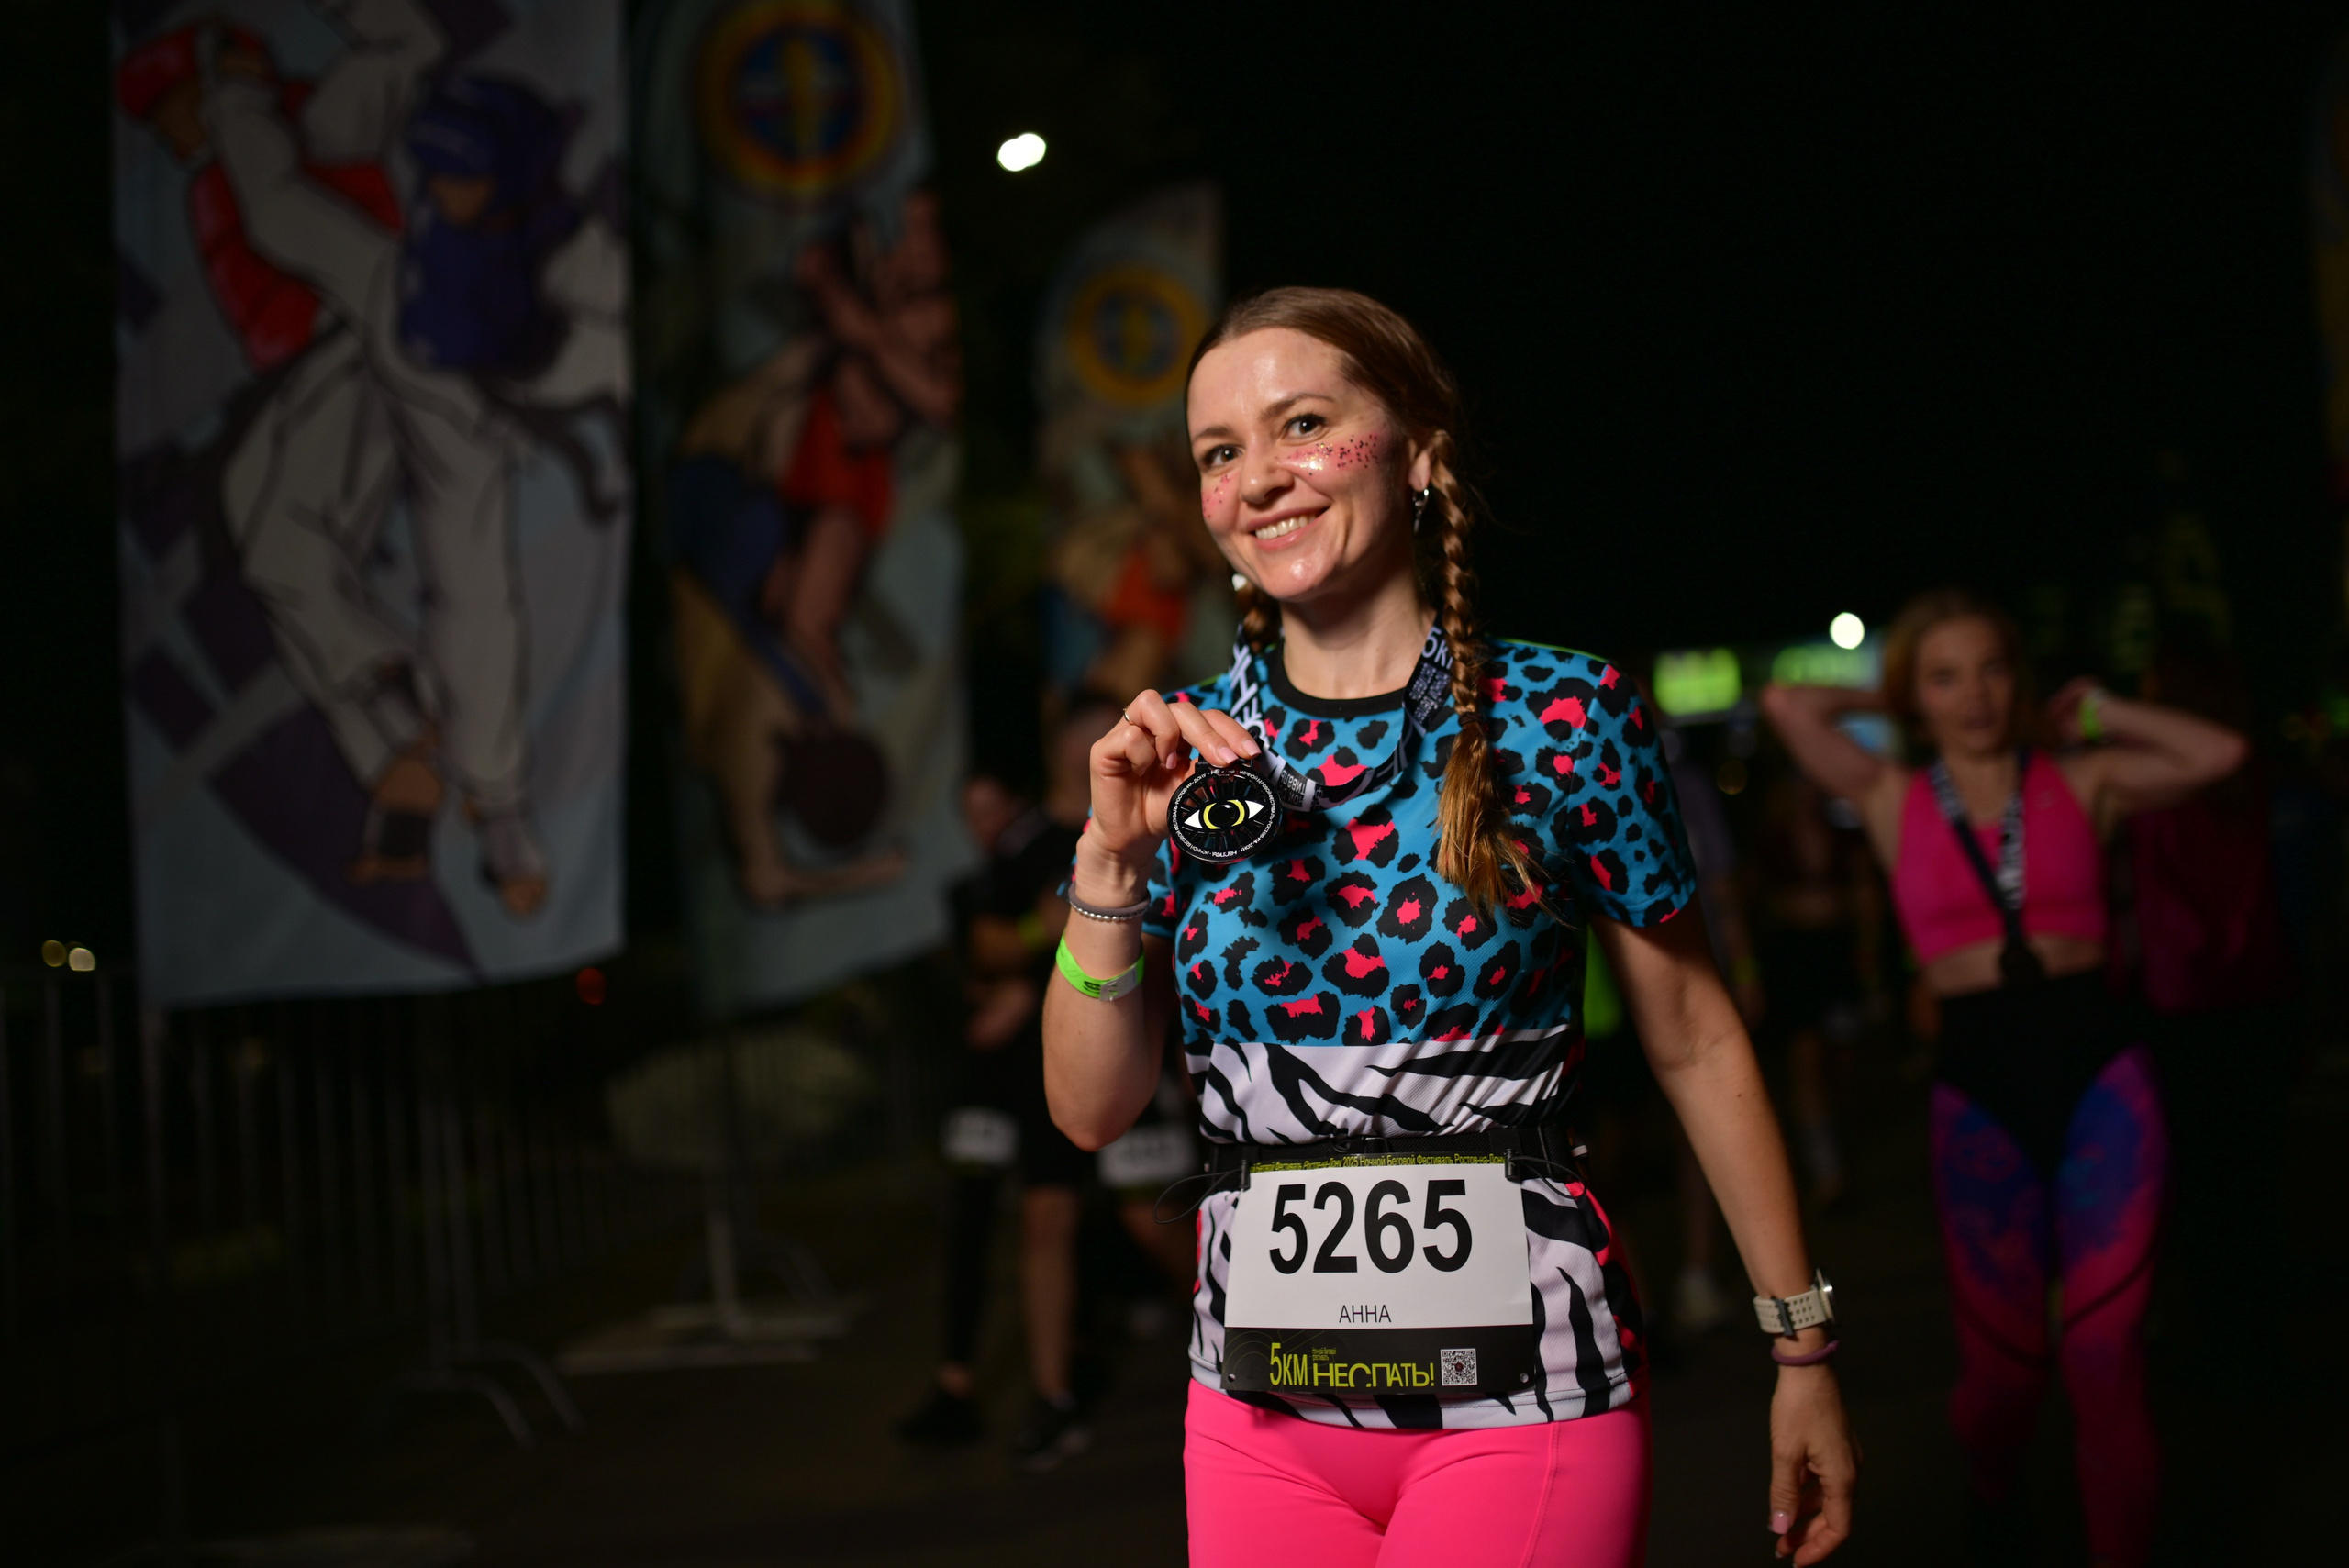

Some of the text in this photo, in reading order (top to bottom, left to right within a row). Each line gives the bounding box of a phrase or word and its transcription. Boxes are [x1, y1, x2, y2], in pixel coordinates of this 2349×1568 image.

[1342, 1156, 1358, 1167] 2025
[1360, 1155, 1386, 1167] Ночной
[1386, 1154, 1415, 1166] Беговой
[1417, 1154, 1453, 1165] Фестиваль
[1269, 1179, 1473, 1274] 5265
[1339, 1304, 1392, 1323] АННА
